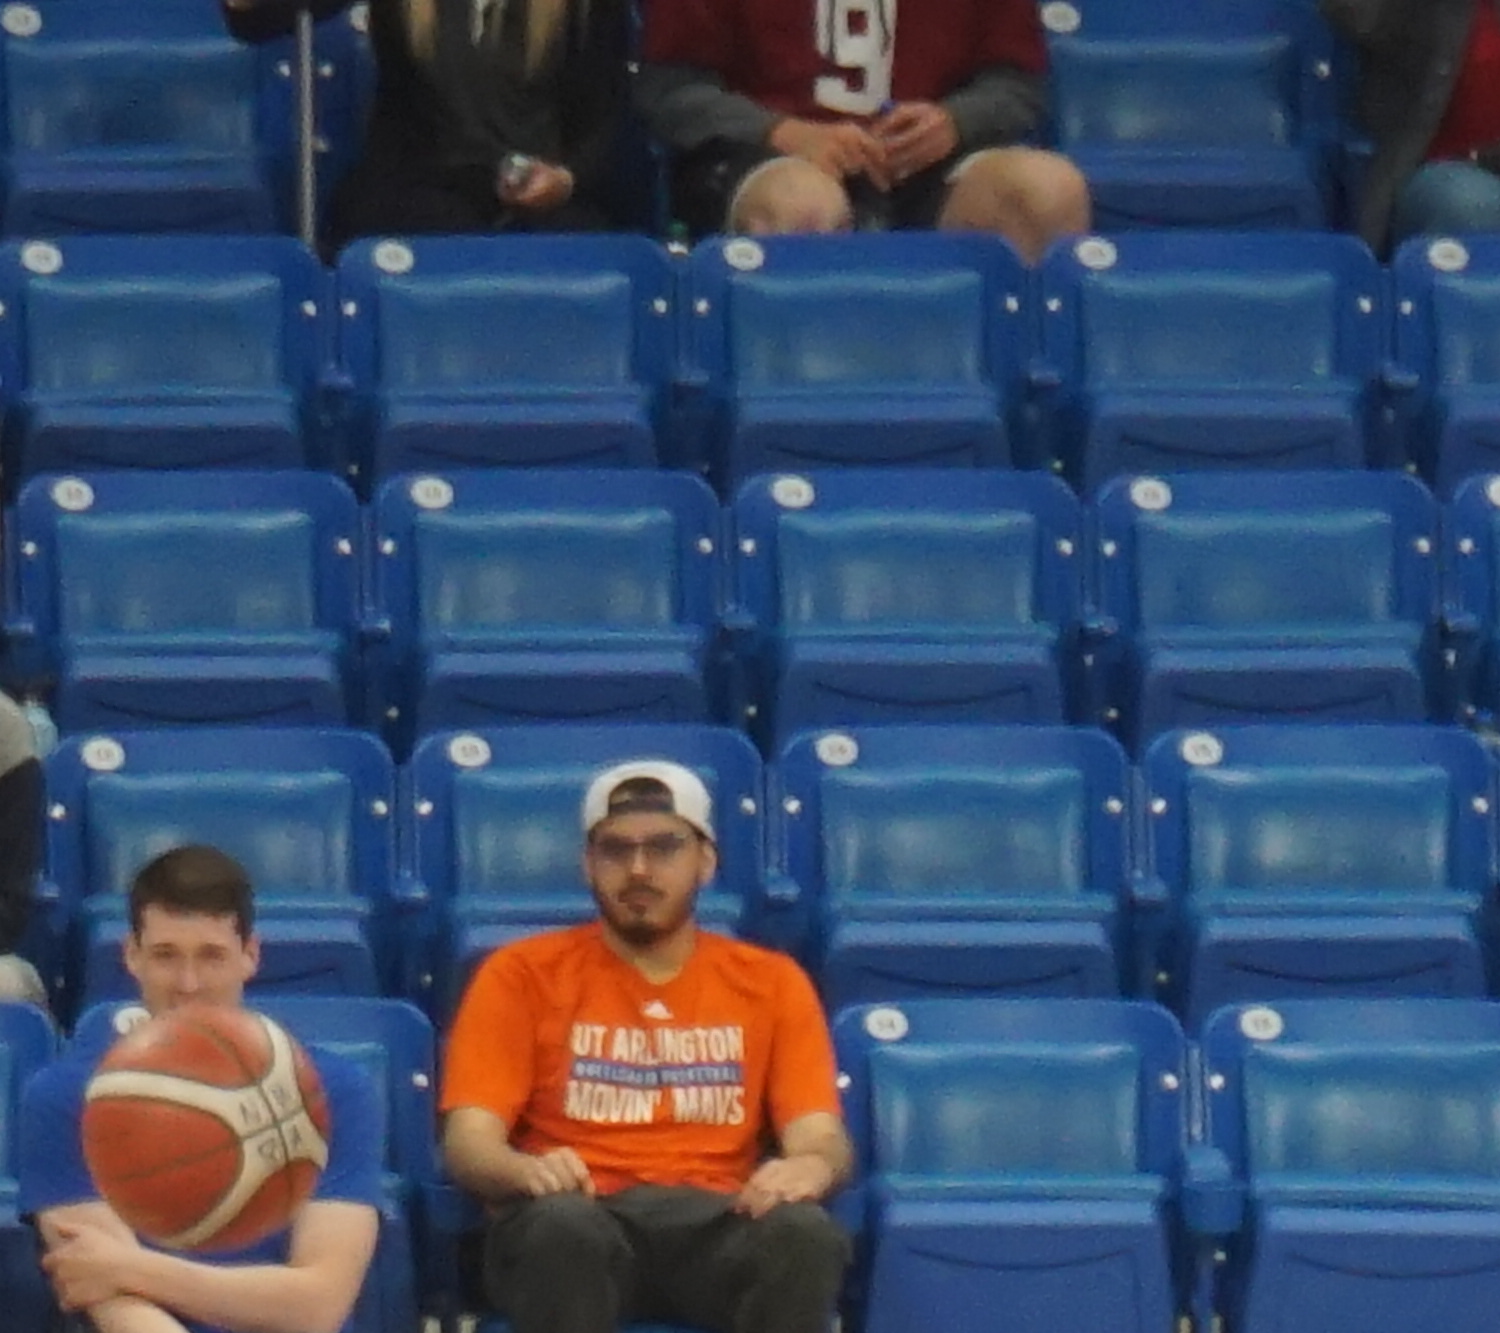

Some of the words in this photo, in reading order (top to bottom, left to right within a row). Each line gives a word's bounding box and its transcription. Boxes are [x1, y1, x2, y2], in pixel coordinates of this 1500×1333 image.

[812, 0, 896, 115] 9
[570, 1022, 608, 1058] UT
[673, 1085, 746, 1125] MAVS
